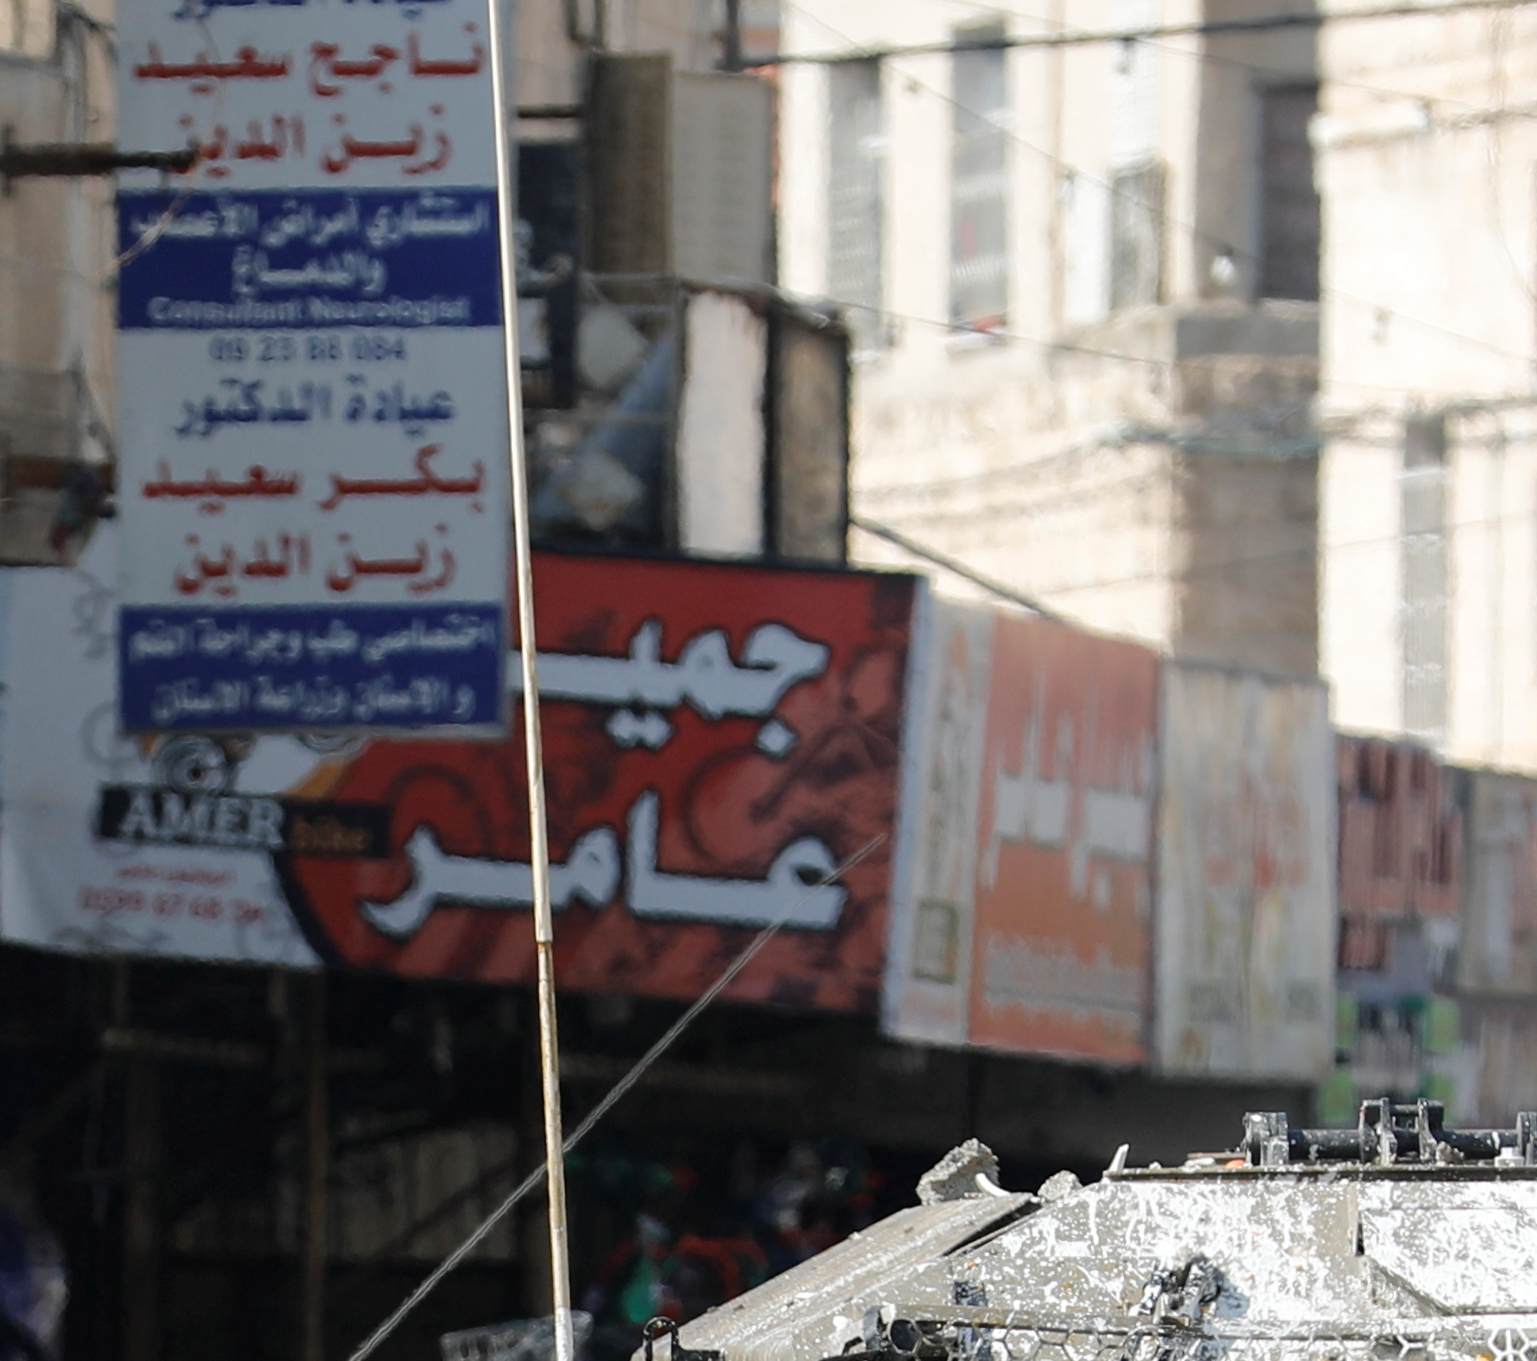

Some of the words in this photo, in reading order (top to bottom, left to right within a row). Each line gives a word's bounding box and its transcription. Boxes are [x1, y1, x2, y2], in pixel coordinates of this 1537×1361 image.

[322, 105, 450, 175] زين
[173, 376, 333, 440] الدكتور
[345, 372, 454, 438] عيادة
[142, 456, 300, 514] سعيد
[321, 444, 485, 514] بكر
[174, 531, 313, 597] الدين
[328, 522, 457, 594] زين
[508, 622, 831, 754] جمي
[118, 793, 285, 848] AMER
[363, 791, 847, 936] عامر
